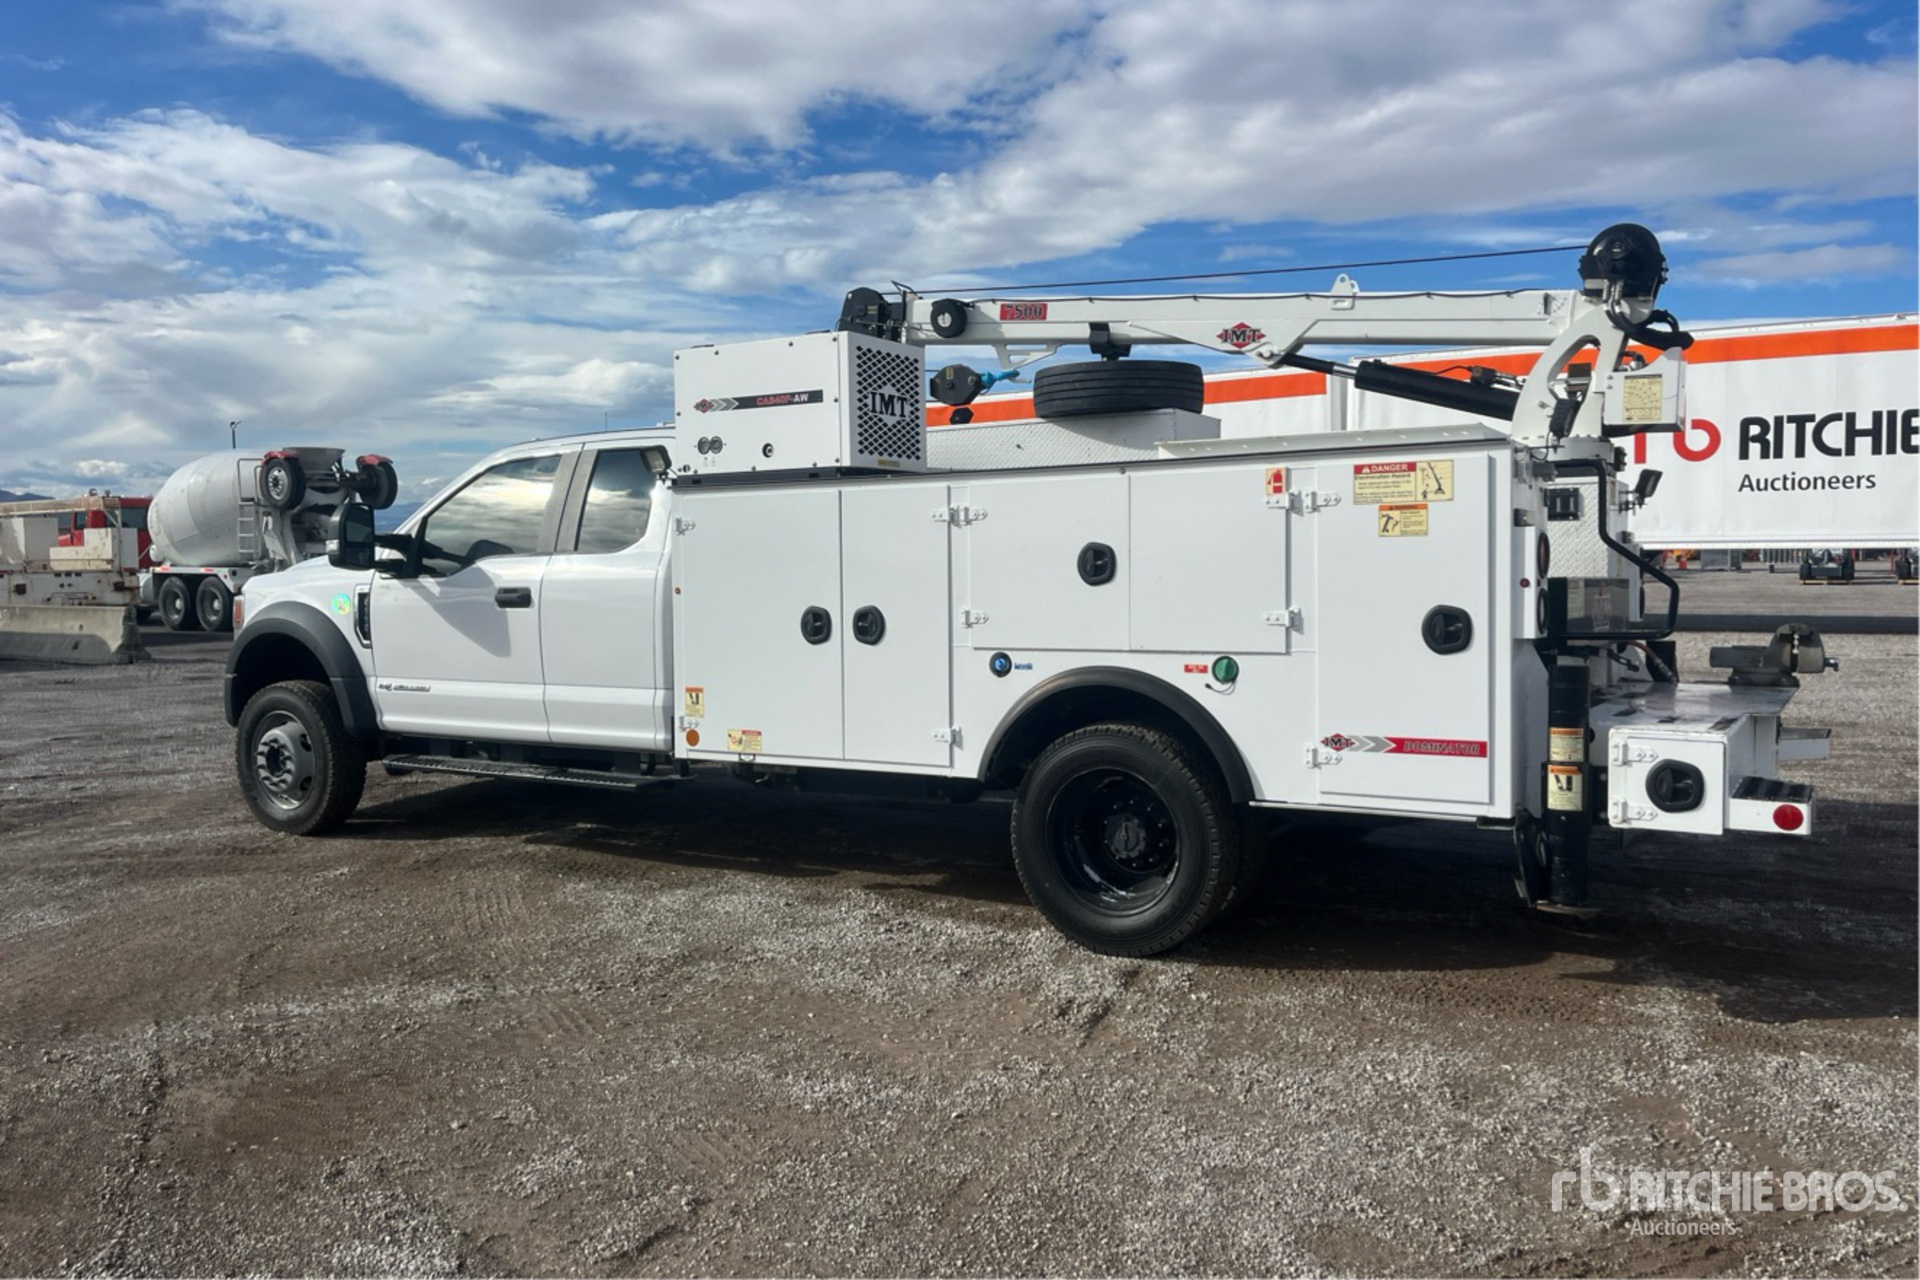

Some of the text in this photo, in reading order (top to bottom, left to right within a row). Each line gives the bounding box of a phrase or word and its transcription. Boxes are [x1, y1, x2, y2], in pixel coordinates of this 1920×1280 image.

[1004, 303, 1043, 319] 7500
[1221, 328, 1262, 343] IMT
[868, 391, 908, 418] IMT
[1739, 409, 1918, 460] RITCHIE
[1371, 464, 1408, 473] DANGER
[1738, 472, 1876, 492] Auctioneers
[1323, 736, 1352, 748] IMT
[1403, 741, 1480, 755] DOMINATOR
